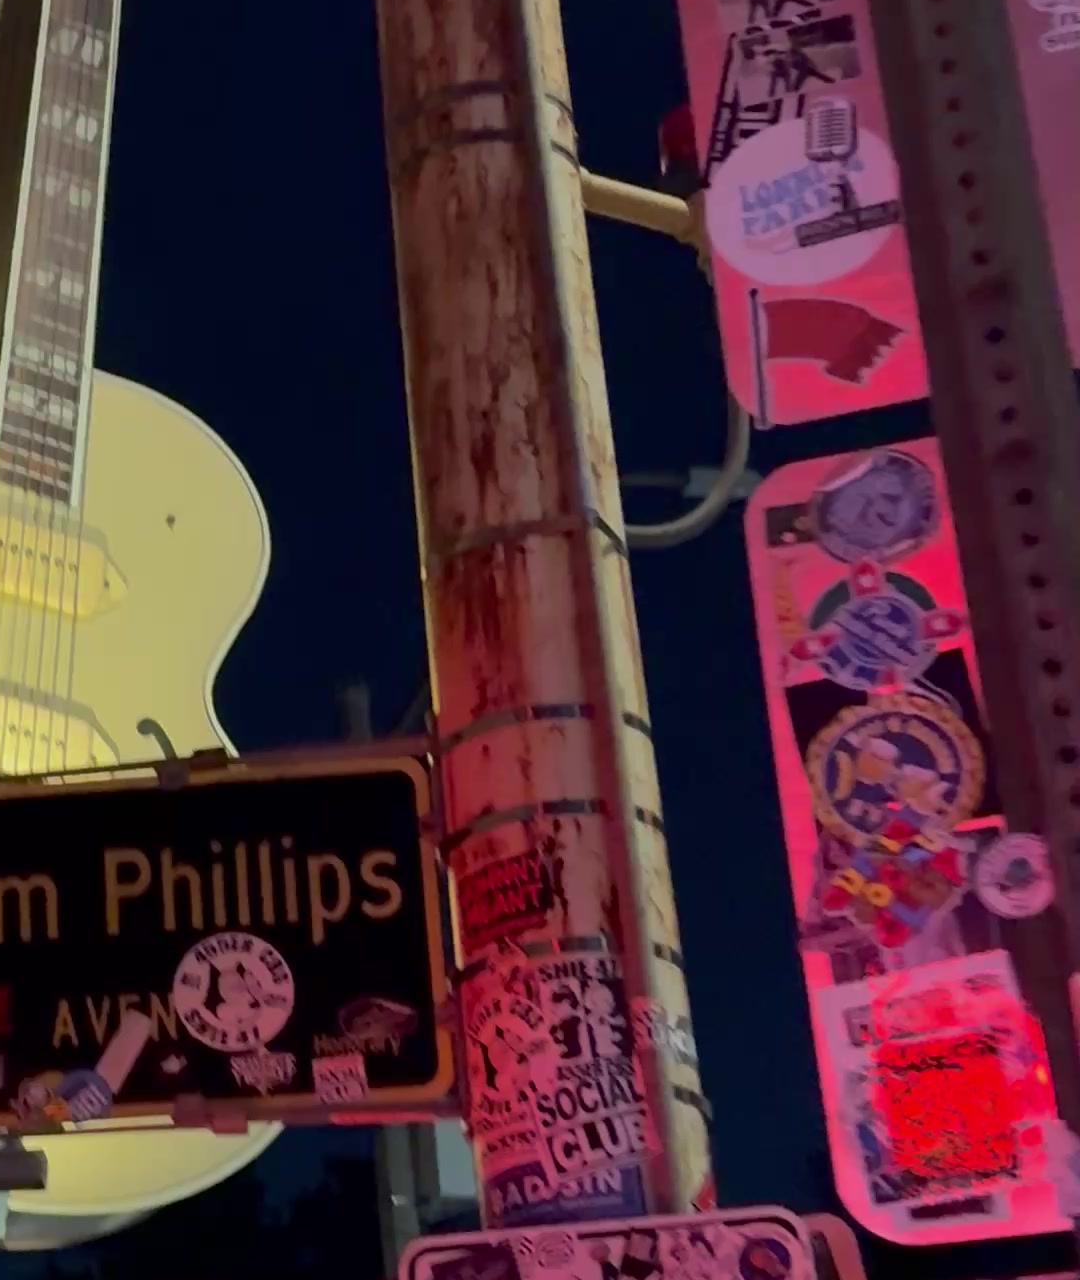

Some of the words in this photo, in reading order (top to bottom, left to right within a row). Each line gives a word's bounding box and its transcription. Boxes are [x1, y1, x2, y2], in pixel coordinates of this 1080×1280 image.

[102, 835, 402, 946] Phillips
[52, 991, 179, 1048] AVEN
[536, 1070, 645, 1128] SOCIAL
